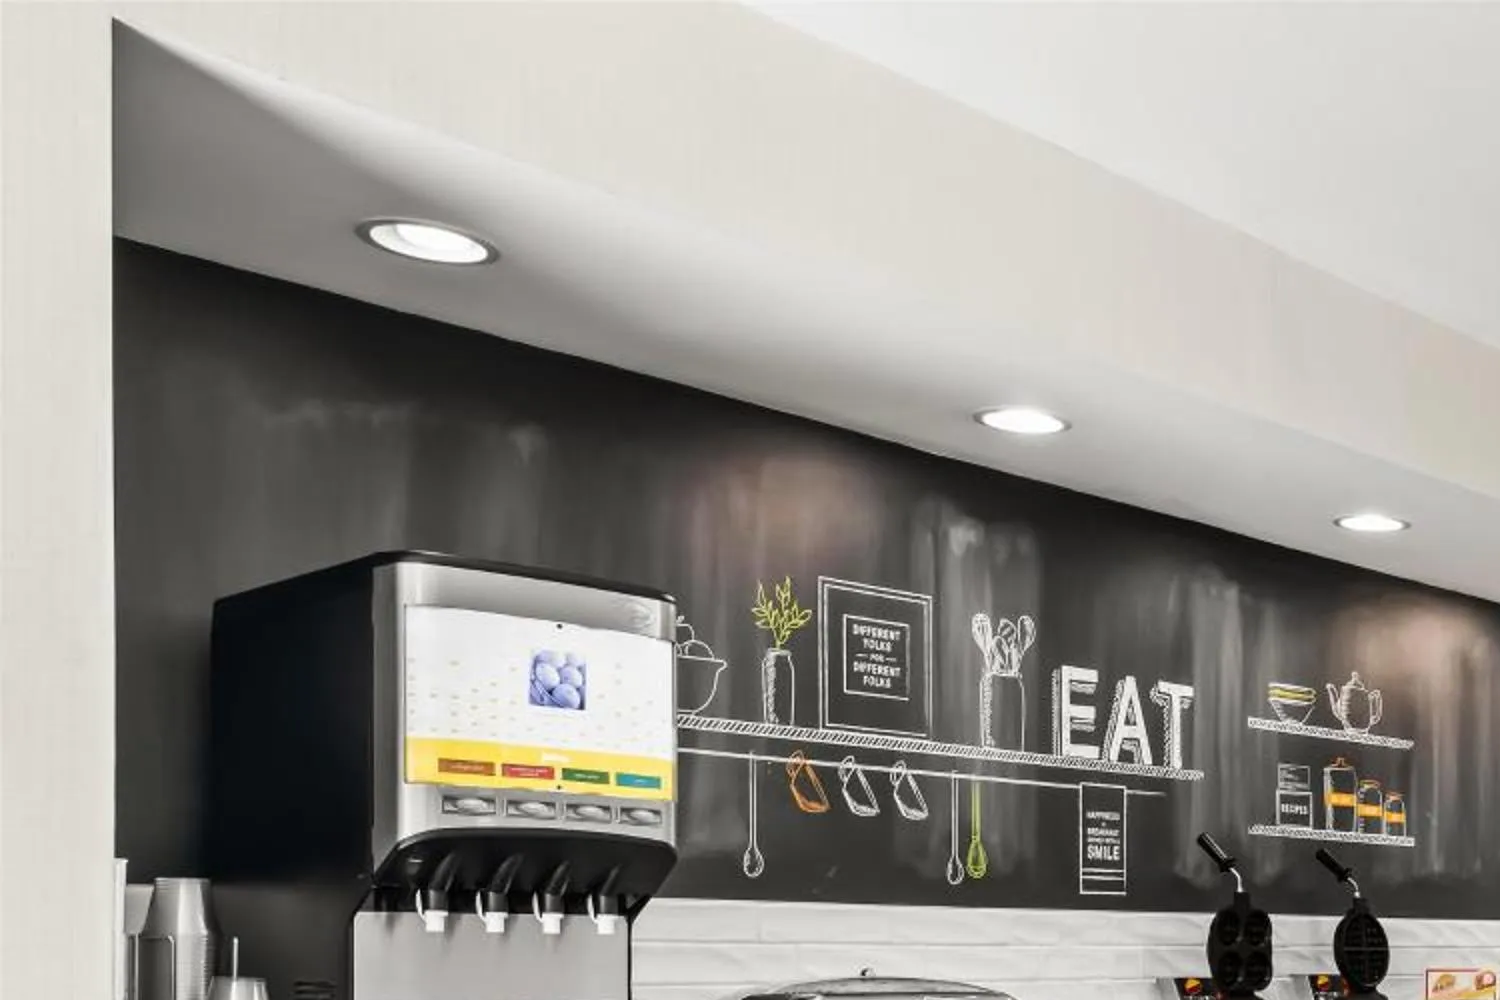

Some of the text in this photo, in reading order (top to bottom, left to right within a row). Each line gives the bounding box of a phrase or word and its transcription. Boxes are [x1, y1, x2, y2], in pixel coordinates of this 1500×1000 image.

[853, 623, 901, 640] DIFFERENT
[853, 660, 901, 676] DIFFERENT
[1052, 665, 1195, 769] EAT
[1087, 844, 1120, 861] SMILE
